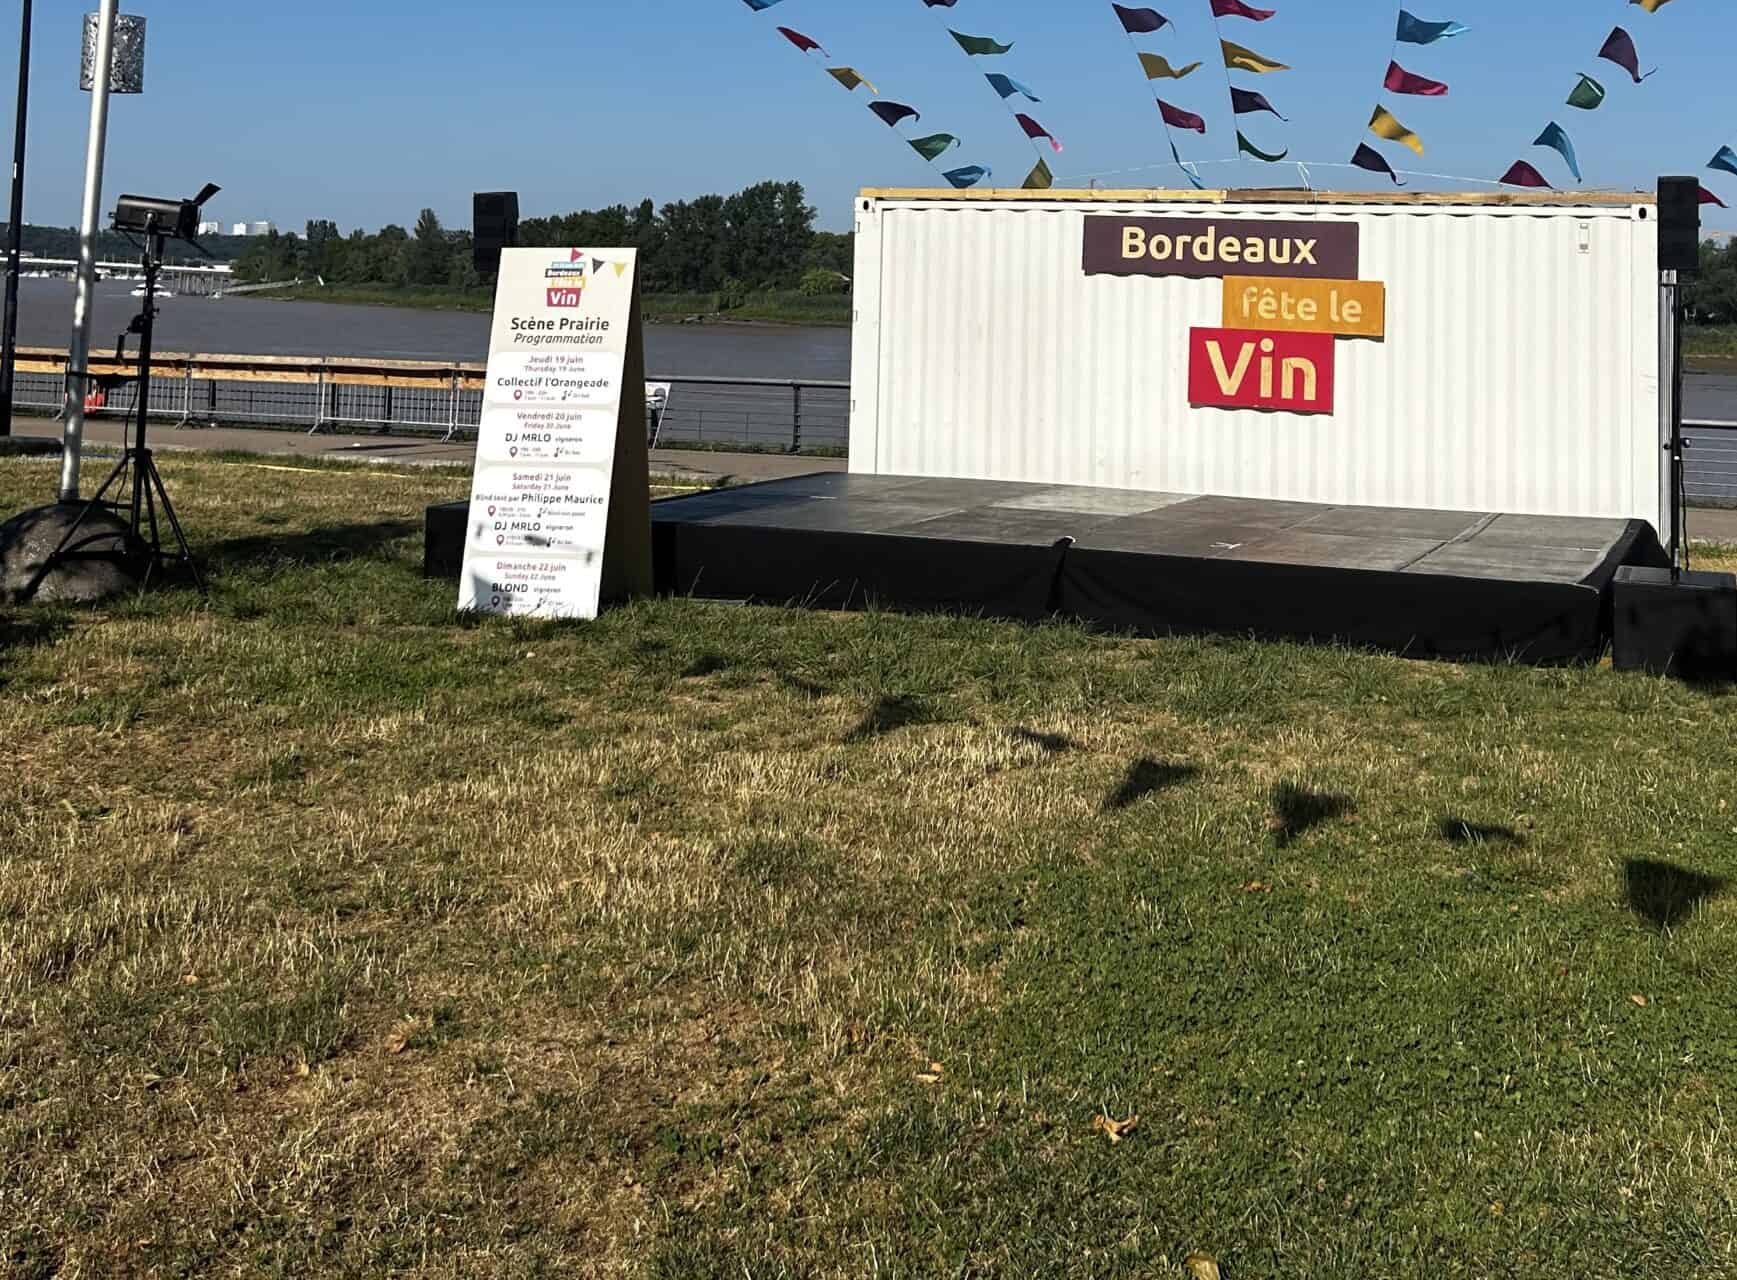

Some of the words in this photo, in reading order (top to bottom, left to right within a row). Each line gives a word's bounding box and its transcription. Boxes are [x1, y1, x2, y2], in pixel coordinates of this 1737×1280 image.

[1121, 225, 1318, 265] Bordeaux
[550, 289, 577, 305] Vin
[1241, 285, 1317, 320] fête
[1330, 290, 1362, 323] le
[510, 315, 554, 331] Scène
[559, 316, 610, 331] Prairie
[513, 332, 603, 346] Programmation
[528, 355, 553, 363] Jeudi
[566, 355, 583, 365] juin
[1205, 338, 1317, 401] Vin
[497, 377, 542, 387] Collectif
[545, 377, 609, 389] l'Orangeade
[517, 412, 553, 420] Vendredi
[566, 413, 582, 422] juin
[505, 433, 518, 442] DJ
[521, 433, 552, 442] MRLO
[512, 472, 543, 481] Samedi
[544, 473, 554, 481] 21
[555, 473, 571, 482] juin
[512, 483, 542, 491] Saturday
[521, 493, 561, 504] Philippe
[564, 494, 604, 504] Maurice
[494, 521, 507, 531] DJ
[510, 522, 541, 531] MRLO
[496, 561, 537, 571] Dimanche
[550, 563, 566, 573] juin
[491, 583, 529, 593] BLOND
